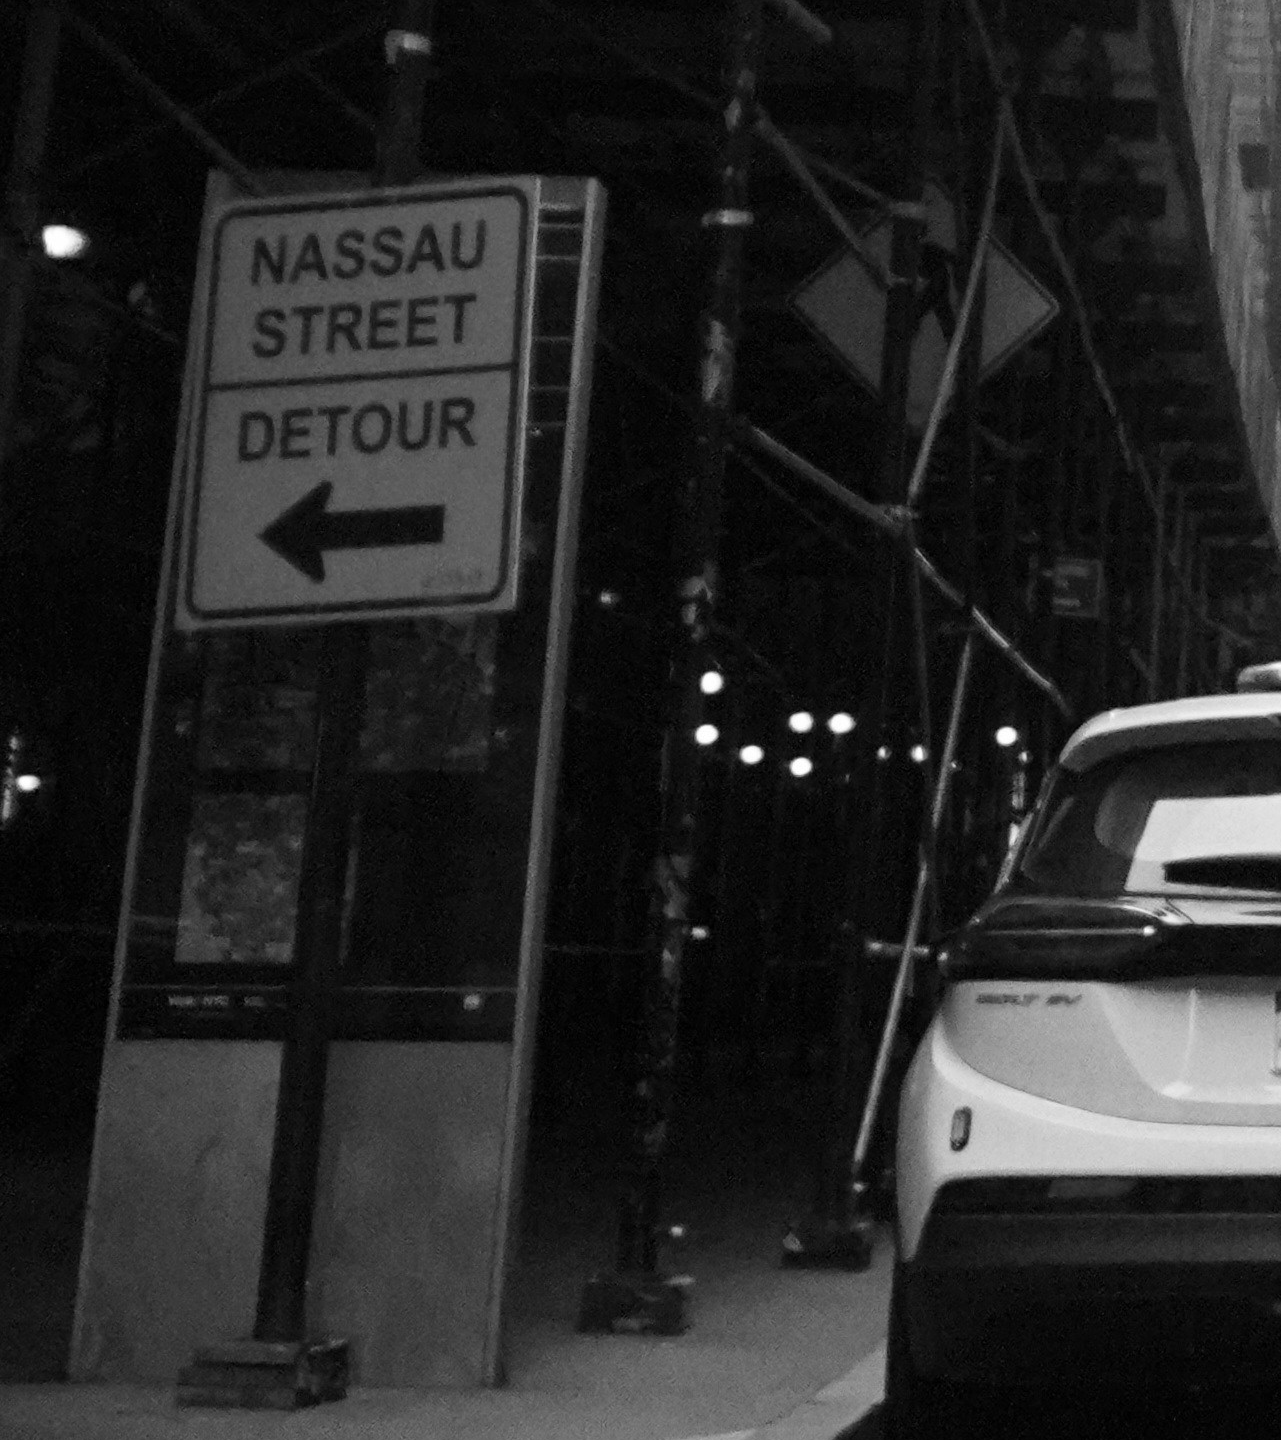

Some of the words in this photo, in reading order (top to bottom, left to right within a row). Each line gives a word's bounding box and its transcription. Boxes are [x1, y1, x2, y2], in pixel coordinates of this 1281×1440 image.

[249, 219, 486, 287] NASSAU
[251, 292, 478, 360] STREET
[237, 396, 476, 464] DETOUR
